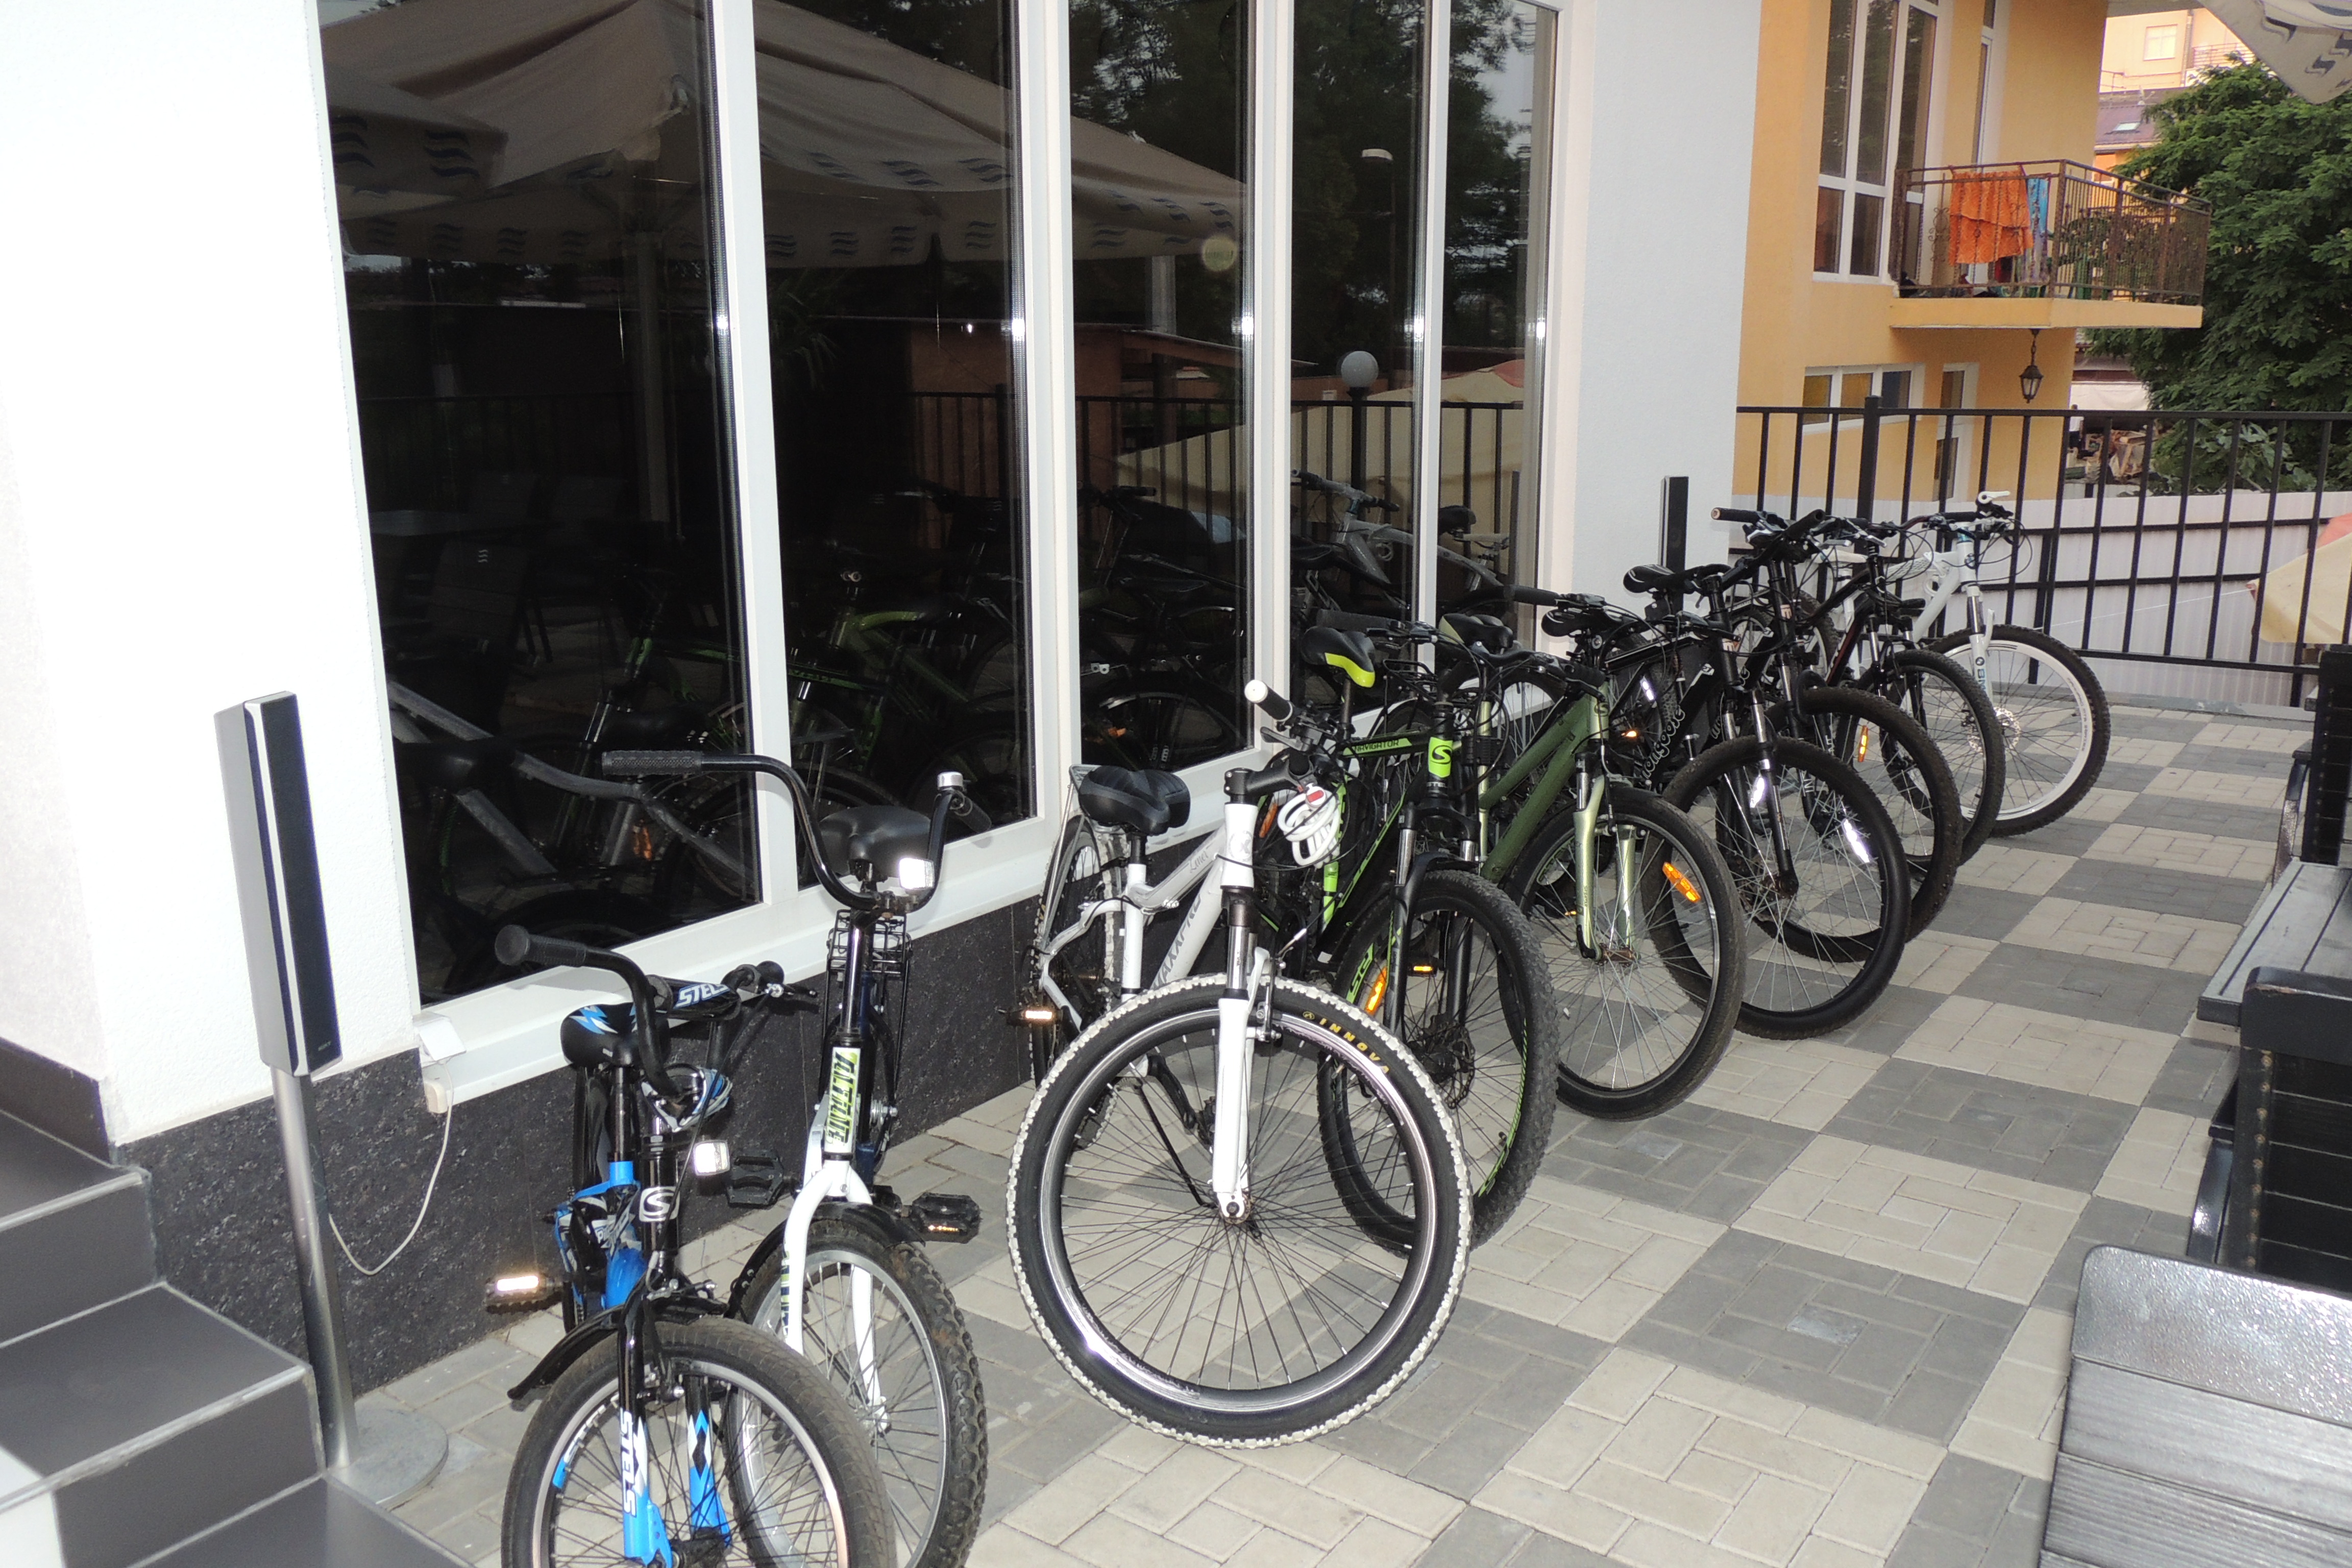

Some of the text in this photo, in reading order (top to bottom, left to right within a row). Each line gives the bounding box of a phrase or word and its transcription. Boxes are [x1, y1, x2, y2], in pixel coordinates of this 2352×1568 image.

[1977, 668, 1987, 690] BM
[1354, 740, 1400, 753] NAVIGATOR
[1319, 1017, 1390, 1074] INNOVA
[619, 1407, 637, 1518] STELS
